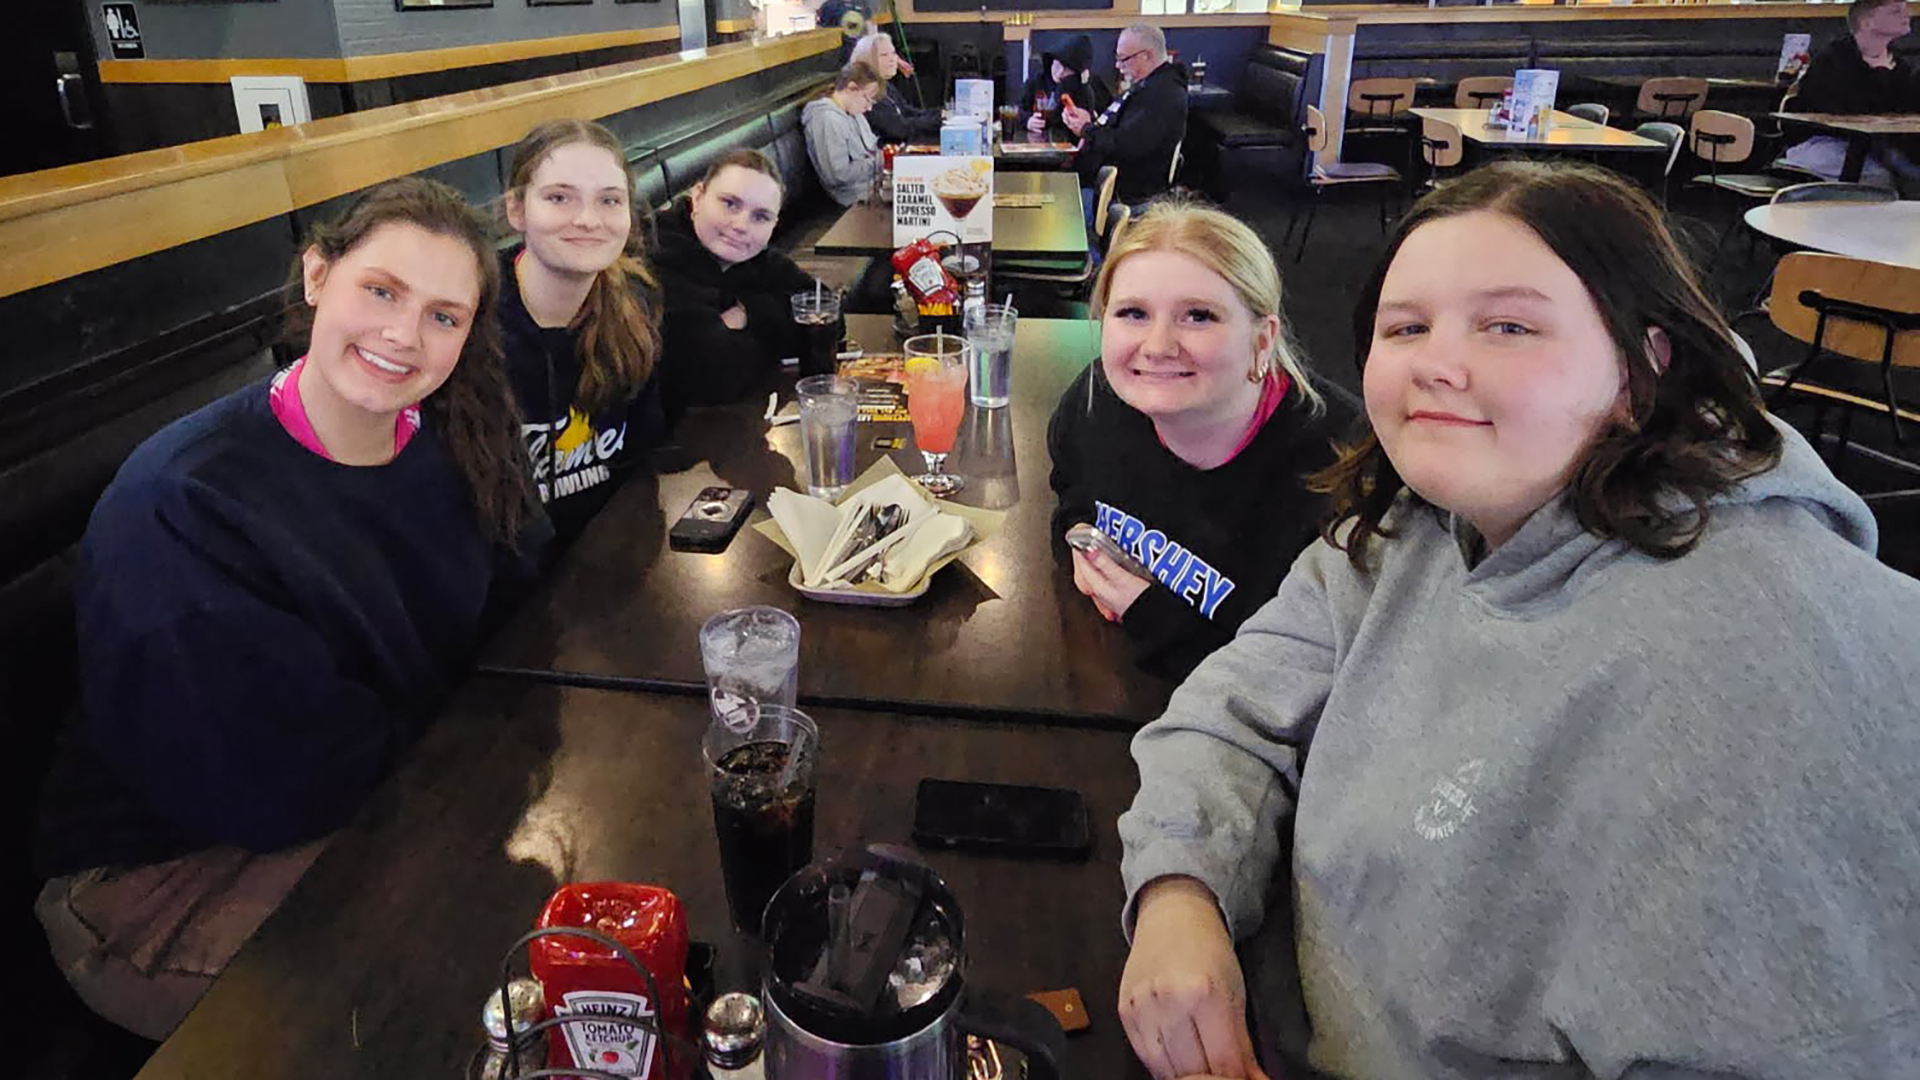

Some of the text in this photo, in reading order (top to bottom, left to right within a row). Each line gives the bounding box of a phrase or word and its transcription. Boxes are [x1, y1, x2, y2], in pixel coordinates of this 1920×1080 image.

[896, 183, 926, 194] SALTED
[896, 194, 934, 205] CARAMEL
[896, 205, 936, 216] ESPRESSO
[896, 216, 931, 226] MARTINI
[1095, 499, 1235, 621] HERSHEY
[580, 1003, 628, 1017] HEINZ
[581, 1021, 635, 1034] TOMATO
[585, 1033, 634, 1043] KETCHUP
